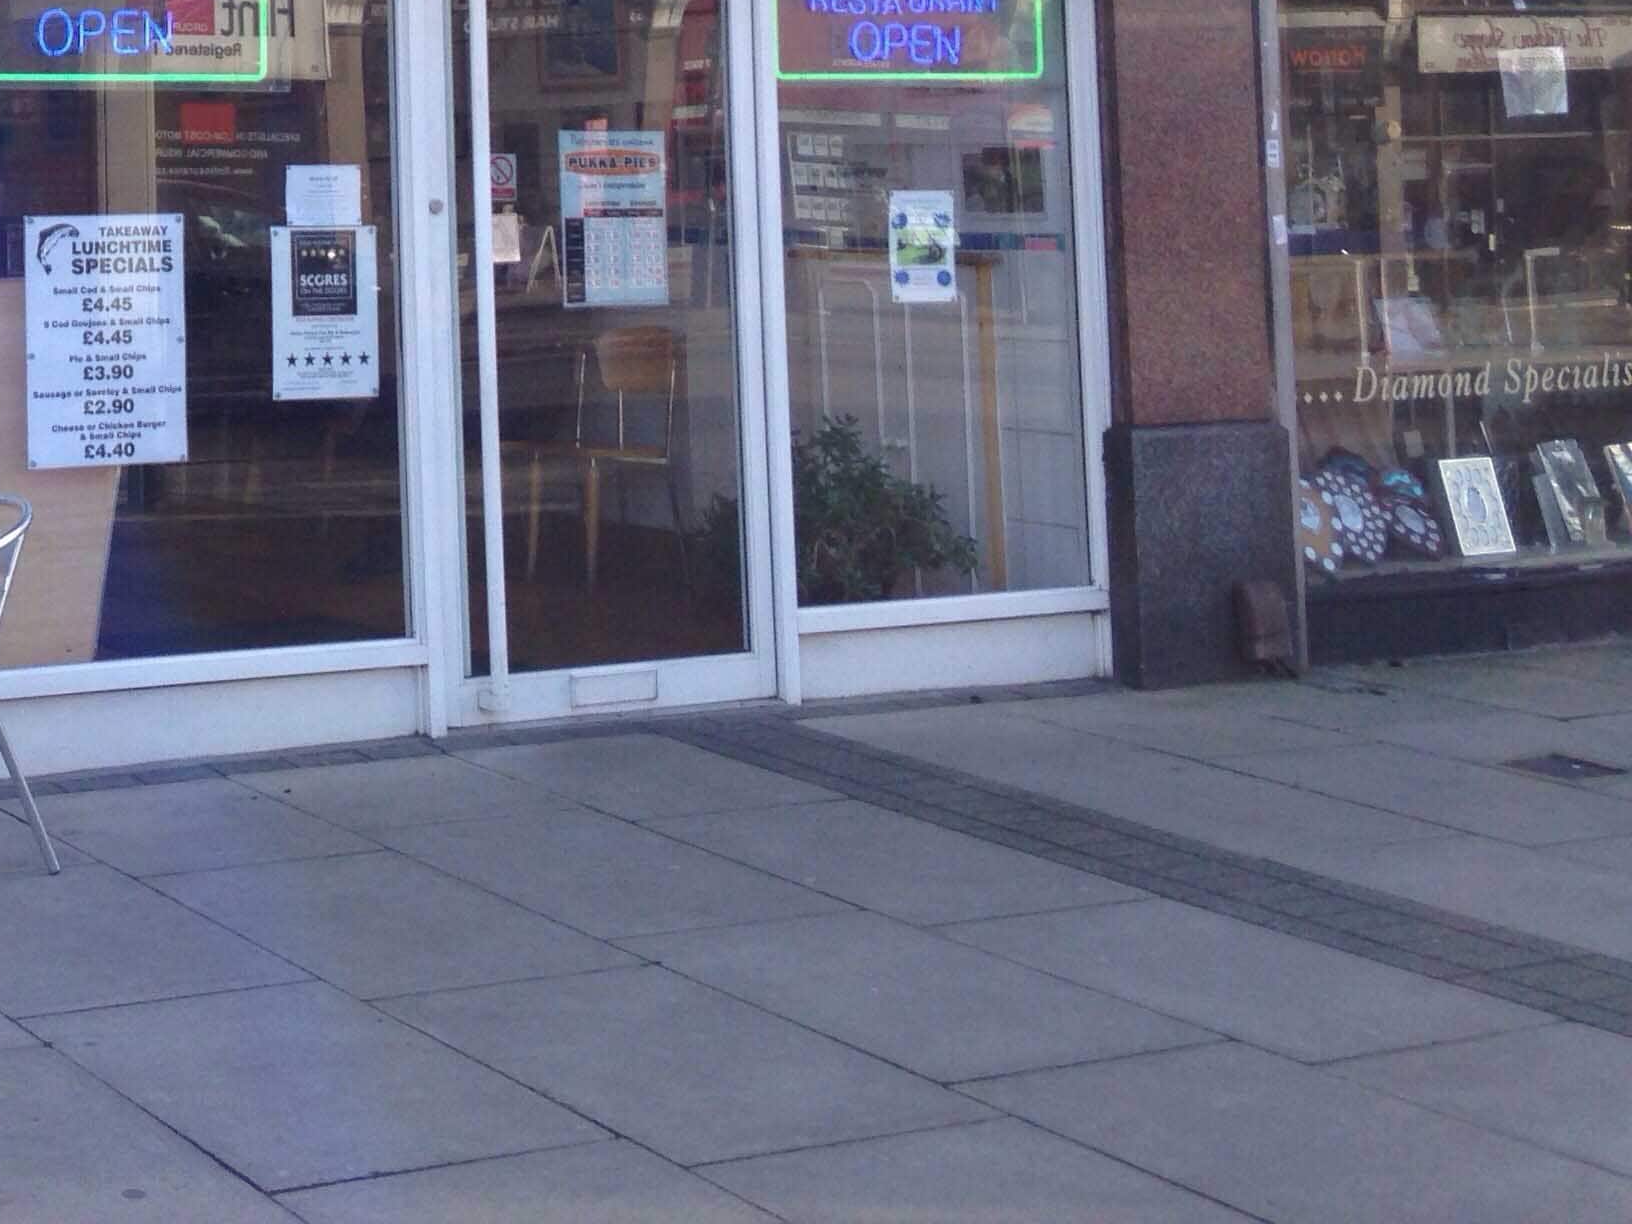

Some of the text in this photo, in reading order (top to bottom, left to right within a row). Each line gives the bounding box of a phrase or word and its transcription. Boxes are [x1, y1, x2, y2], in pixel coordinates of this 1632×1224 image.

[35, 6, 175, 57] OPEN
[849, 20, 963, 65] OPEN
[568, 156, 657, 169] PUKKA PIES
[99, 226, 168, 237] TAKEAWAY
[71, 240, 172, 255] LUNCHTIME
[71, 256, 173, 275] SPECIALS
[299, 273, 347, 287] SCORES
[53, 286, 78, 295] Small
[80, 286, 97, 295] Cod
[109, 285, 134, 294] Small
[136, 284, 161, 294] Chips
[82, 297, 132, 313] £4.45
[51, 320, 69, 328] Cod
[71, 319, 106, 329] Goujons
[119, 317, 143, 326] Small
[146, 317, 170, 326] Chips
[82, 329, 132, 345] £4.45
[69, 354, 83, 363] Pie
[95, 353, 120, 361] Small
[121, 352, 146, 362] Chips
[83, 364, 134, 381] £3.90
[1353, 359, 1491, 403] Diamond
[33, 390, 72, 400] Sausage
[131, 385, 156, 394] Small
[158, 385, 182, 394] Chips
[83, 398, 134, 415] £2.90
[52, 424, 84, 432] Cheese
[98, 422, 134, 430] Chicken
[137, 420, 166, 429] Burger
[89, 431, 114, 440] Small
[117, 430, 142, 440] Chips
[84, 442, 135, 459] £4.40
